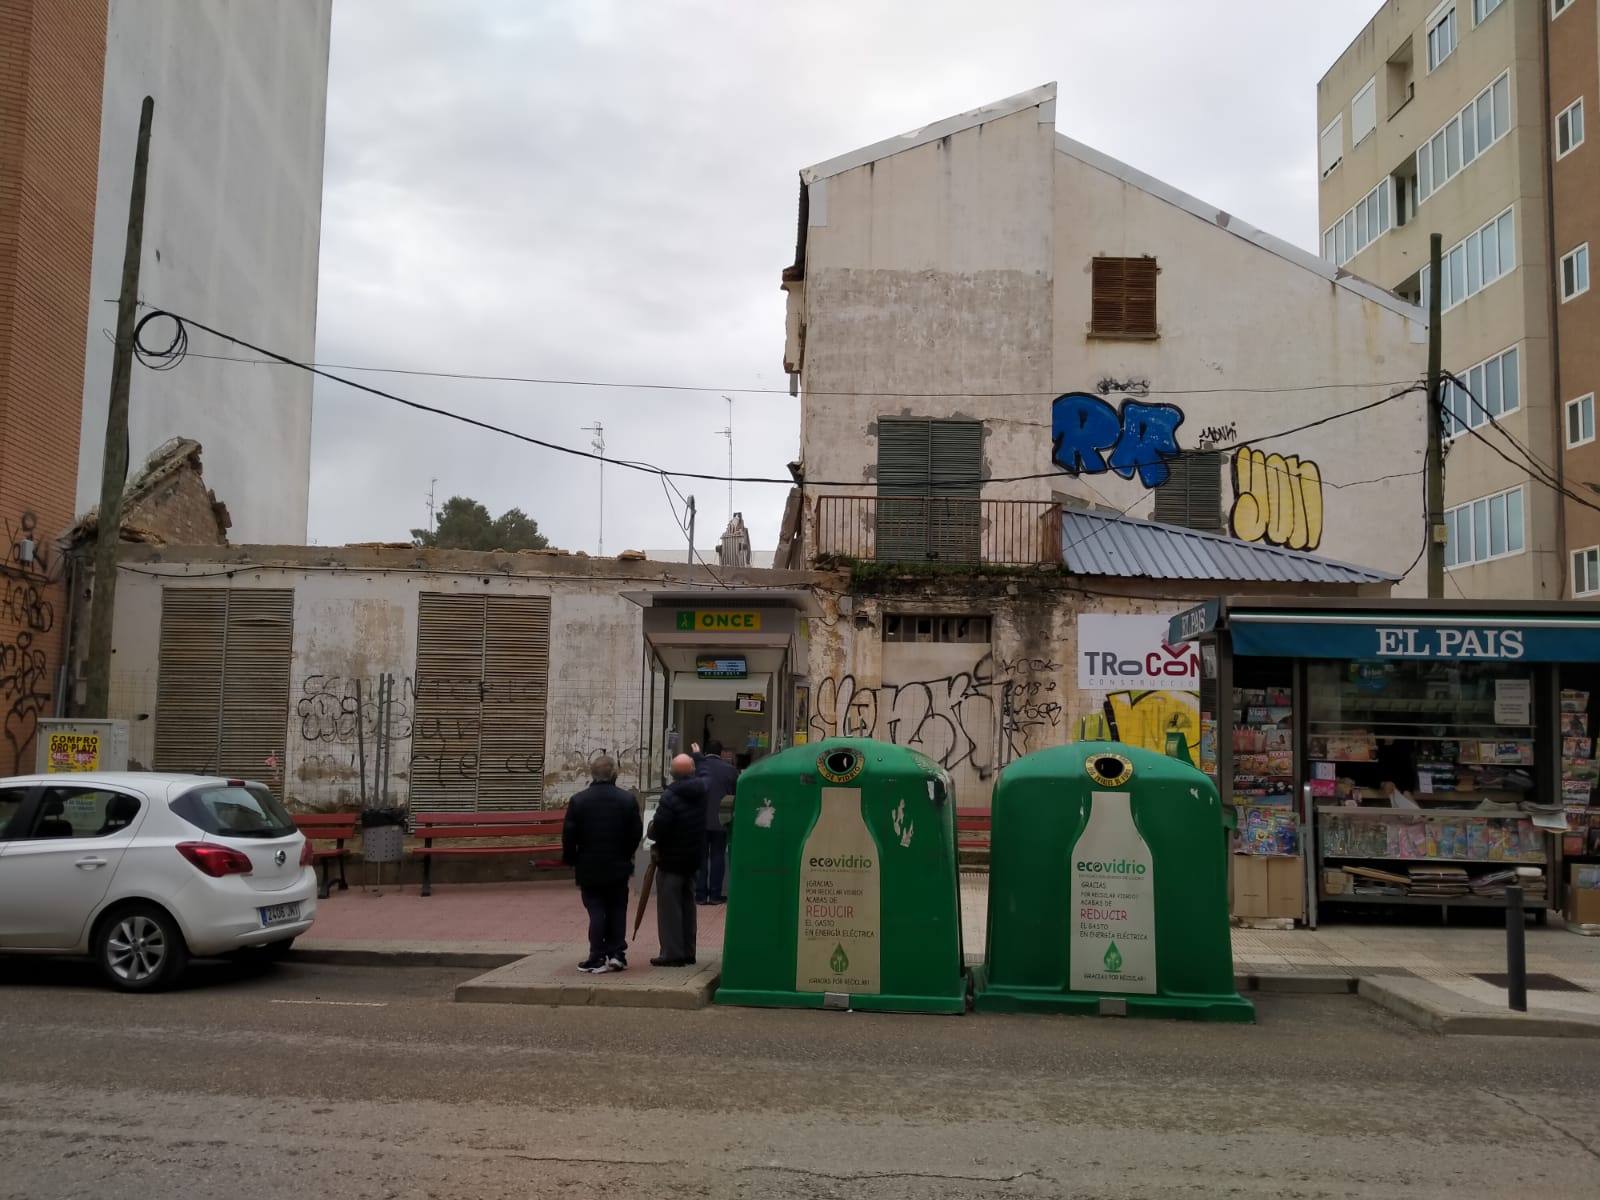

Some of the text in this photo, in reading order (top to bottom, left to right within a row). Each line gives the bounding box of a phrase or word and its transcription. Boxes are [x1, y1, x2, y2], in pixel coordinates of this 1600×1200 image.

[702, 614, 754, 627] ONCE
[1376, 628, 1524, 658] EL PAIS
[51, 736, 98, 744] COMPRO
[51, 743, 96, 754] ORO PLATA
[838, 766, 860, 782] VIDRIO
[810, 854, 872, 868] ecovidrio
[1077, 859, 1146, 874] ecovidrio
[806, 905, 854, 918] REDUCIR
[1080, 908, 1128, 920] REDUCIR
[805, 928, 814, 936] EN
